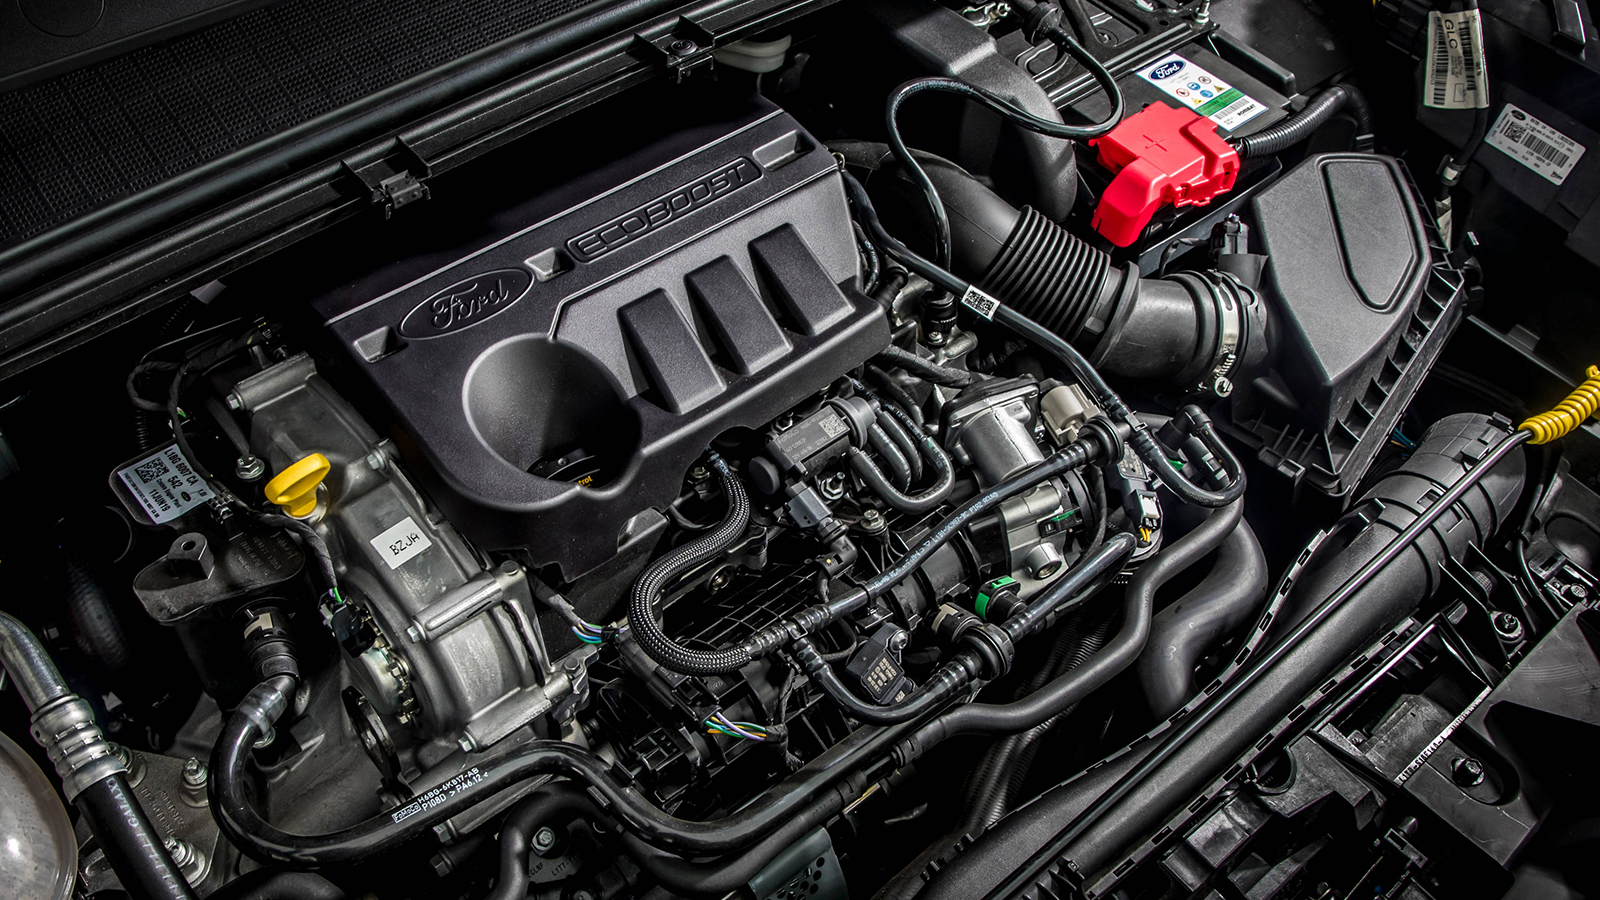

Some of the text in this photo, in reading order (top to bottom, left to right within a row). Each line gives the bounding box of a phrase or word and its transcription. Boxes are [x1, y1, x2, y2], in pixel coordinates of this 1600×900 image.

[1443, 18, 1458, 49] GLC
[1155, 63, 1180, 79] Ford
[574, 162, 750, 259] ECOBOOST
[428, 279, 510, 332] Ford
[163, 447, 181, 465] L1BG
[174, 461, 192, 477] 6007
[185, 474, 199, 486] CA
[577, 474, 593, 486] trol
[166, 474, 183, 490] 542
[148, 487, 171, 512] 11JUN19
[388, 531, 421, 555] BZJA
[417, 767, 480, 804] H6BG-6KB17-AB
[394, 803, 420, 822] FoMoCo
[421, 794, 447, 812] P108D
